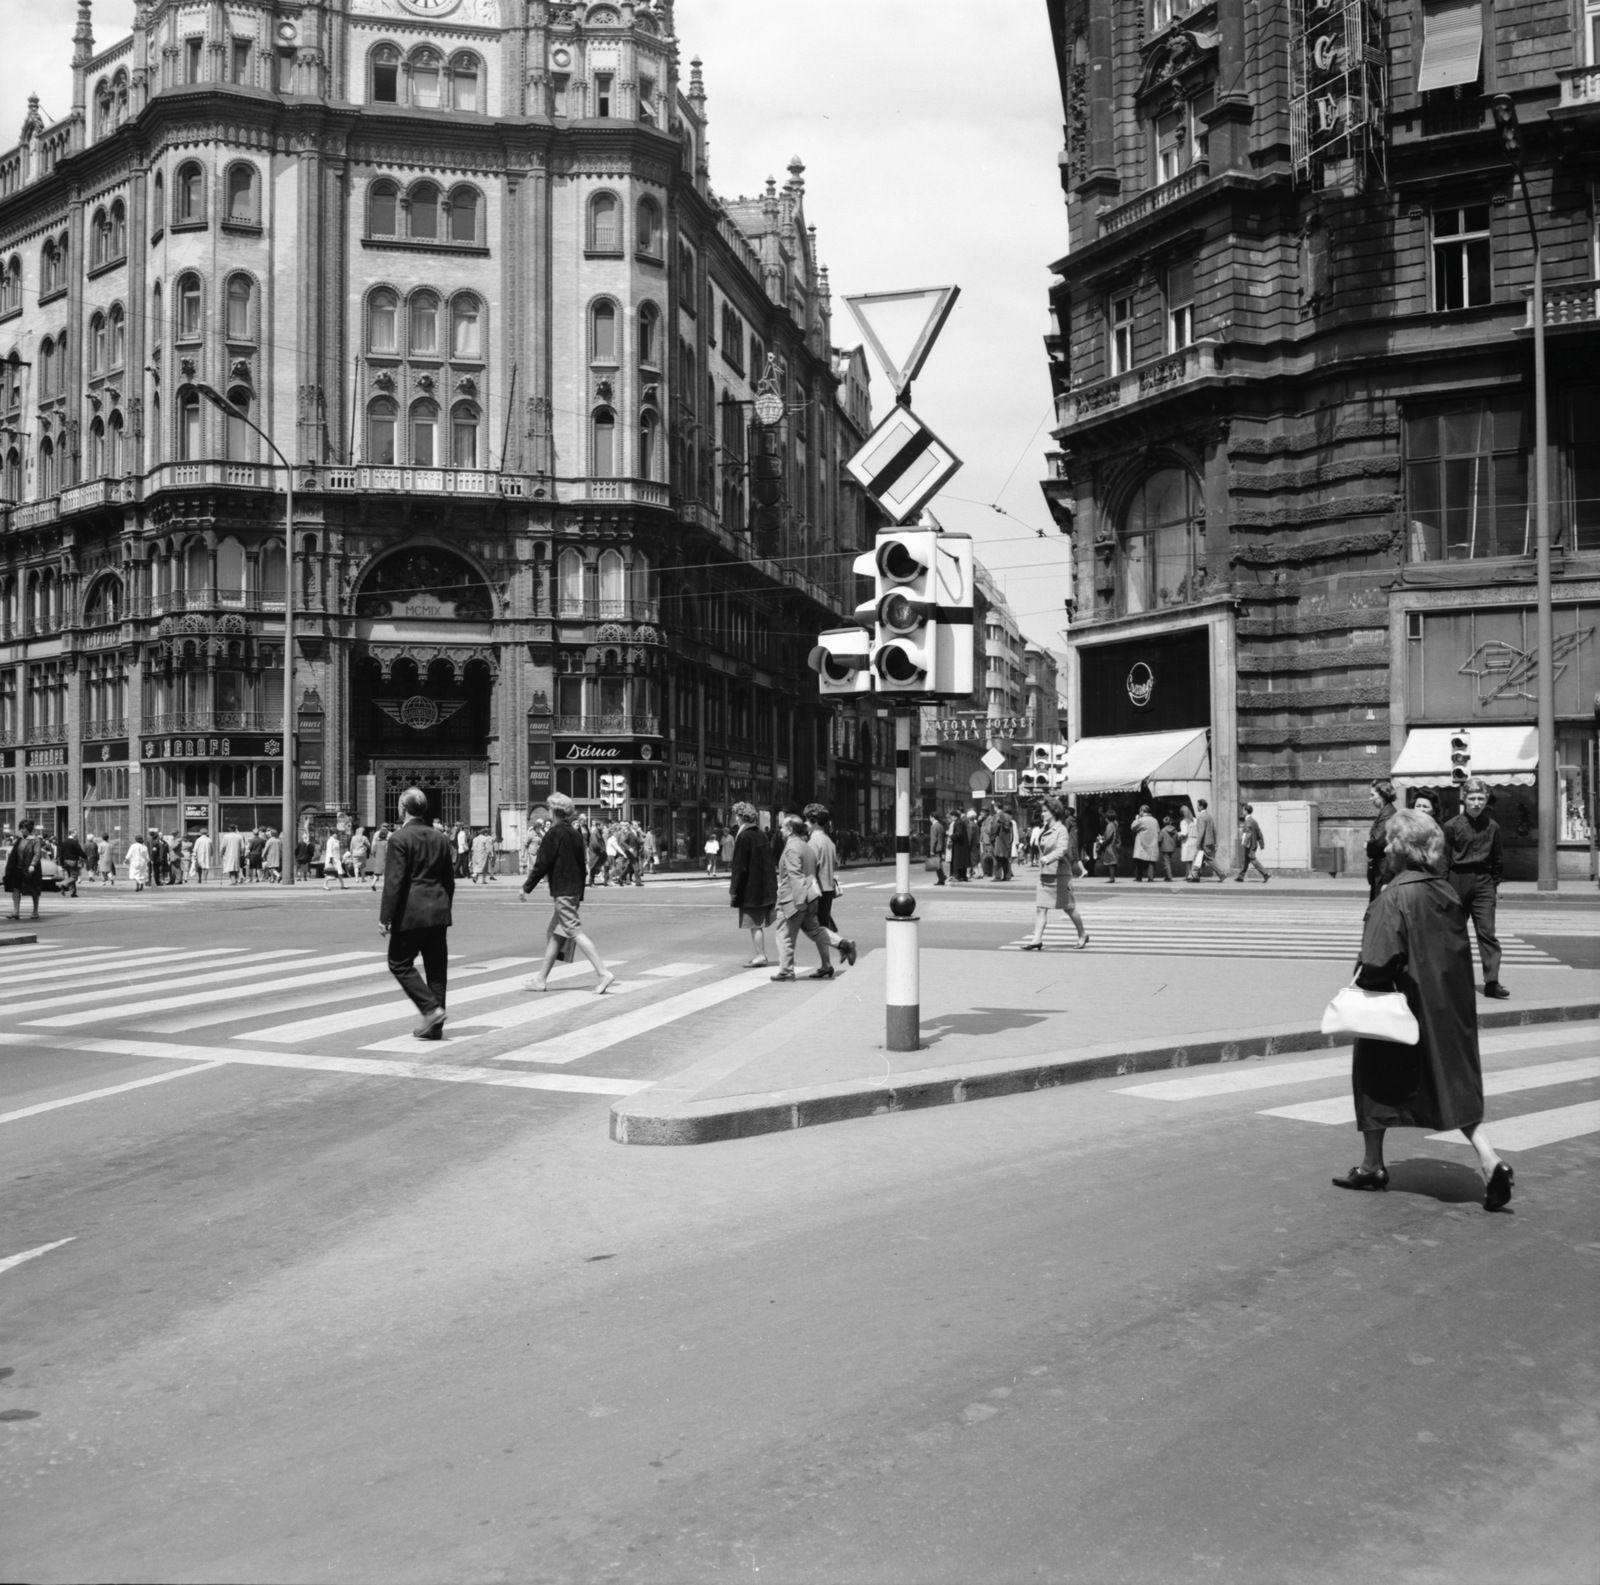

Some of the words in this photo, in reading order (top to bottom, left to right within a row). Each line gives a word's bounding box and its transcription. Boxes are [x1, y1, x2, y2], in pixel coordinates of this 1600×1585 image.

[405, 605, 441, 615] MCMIX
[926, 719, 977, 730] KATONA
[299, 771, 321, 780] IBUSZ
[529, 771, 550, 780] IBUSZ
